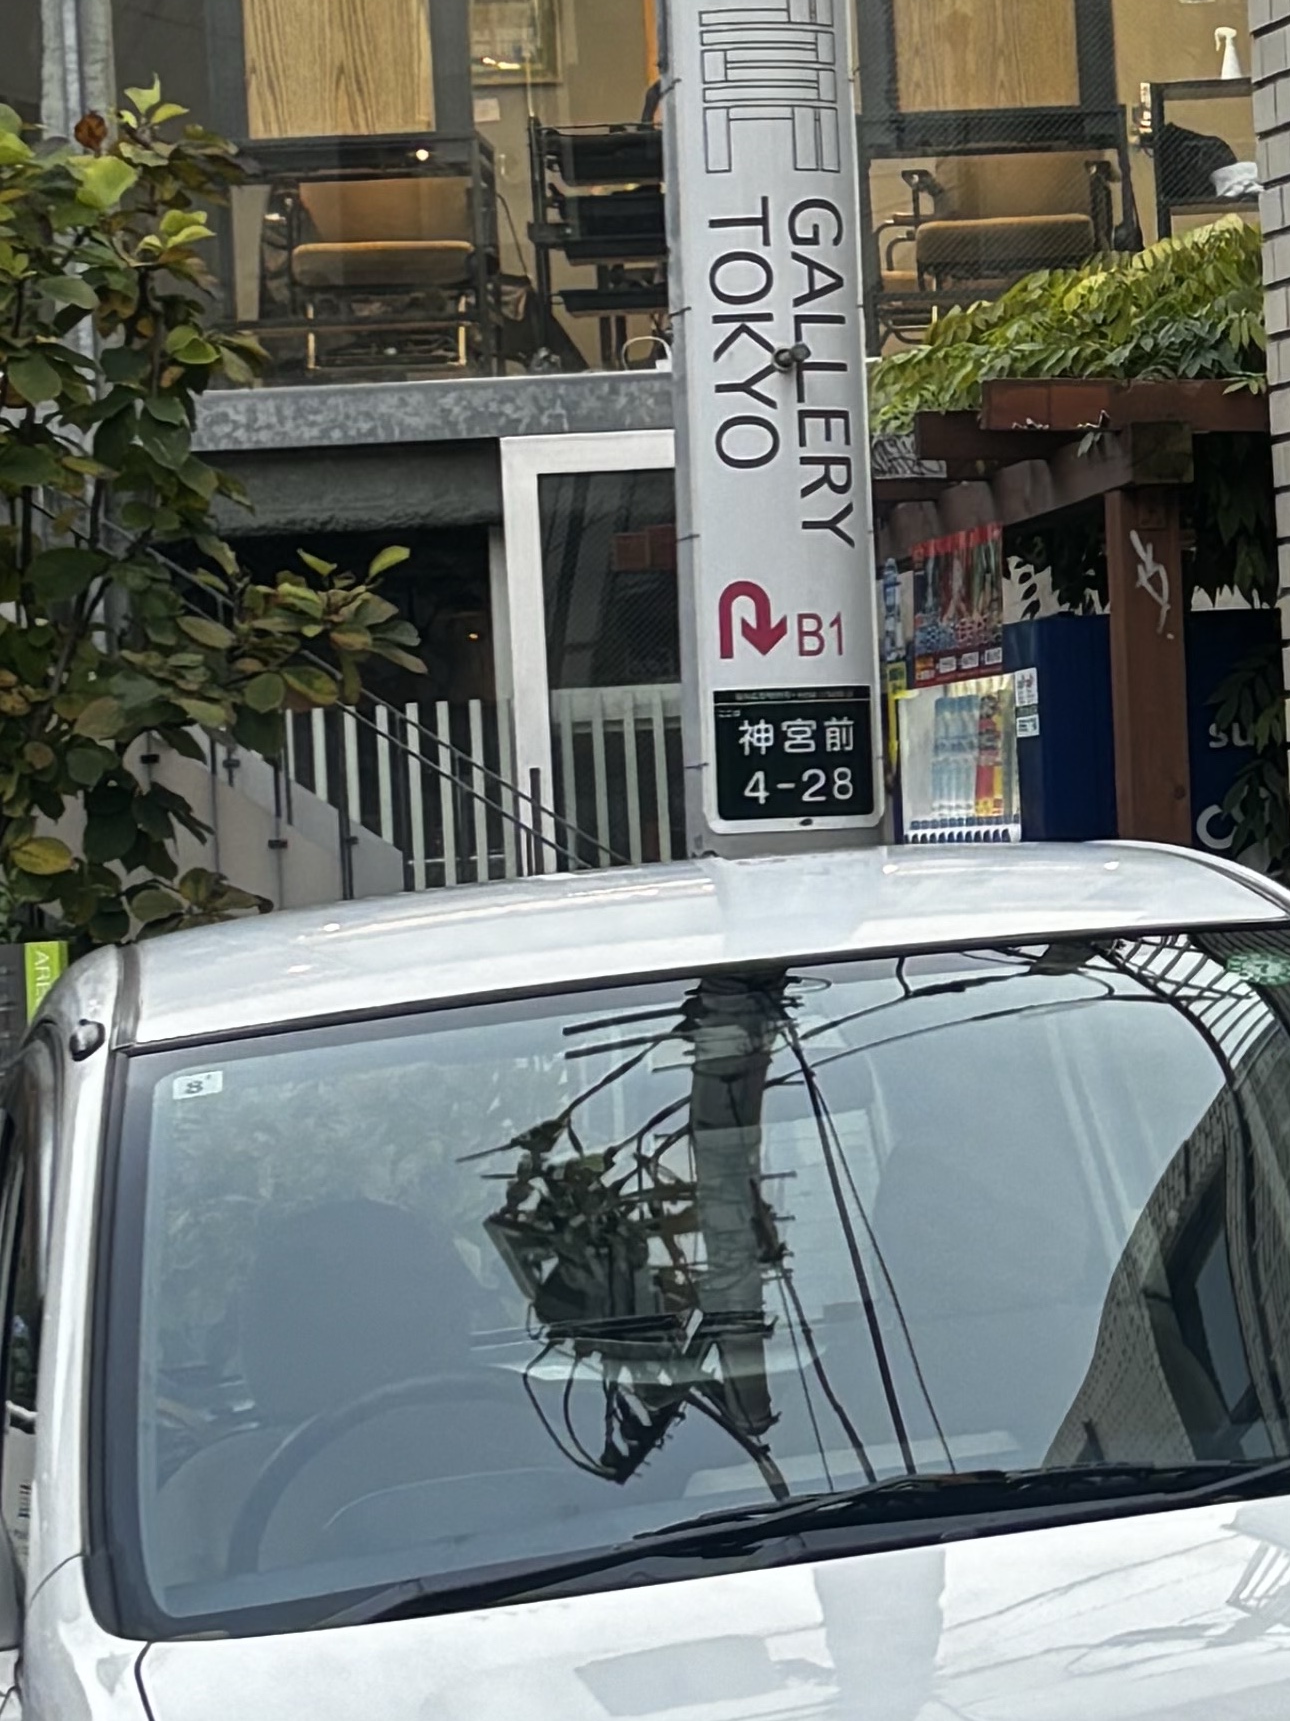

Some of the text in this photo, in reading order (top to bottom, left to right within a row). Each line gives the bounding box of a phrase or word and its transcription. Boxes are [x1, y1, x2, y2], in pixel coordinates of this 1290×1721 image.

[708, 195, 781, 471] TOKYO
[787, 198, 857, 549] GALLERY
[797, 612, 845, 657] B1
[738, 716, 855, 756] 神宮前
[743, 767, 854, 805] 4-28
